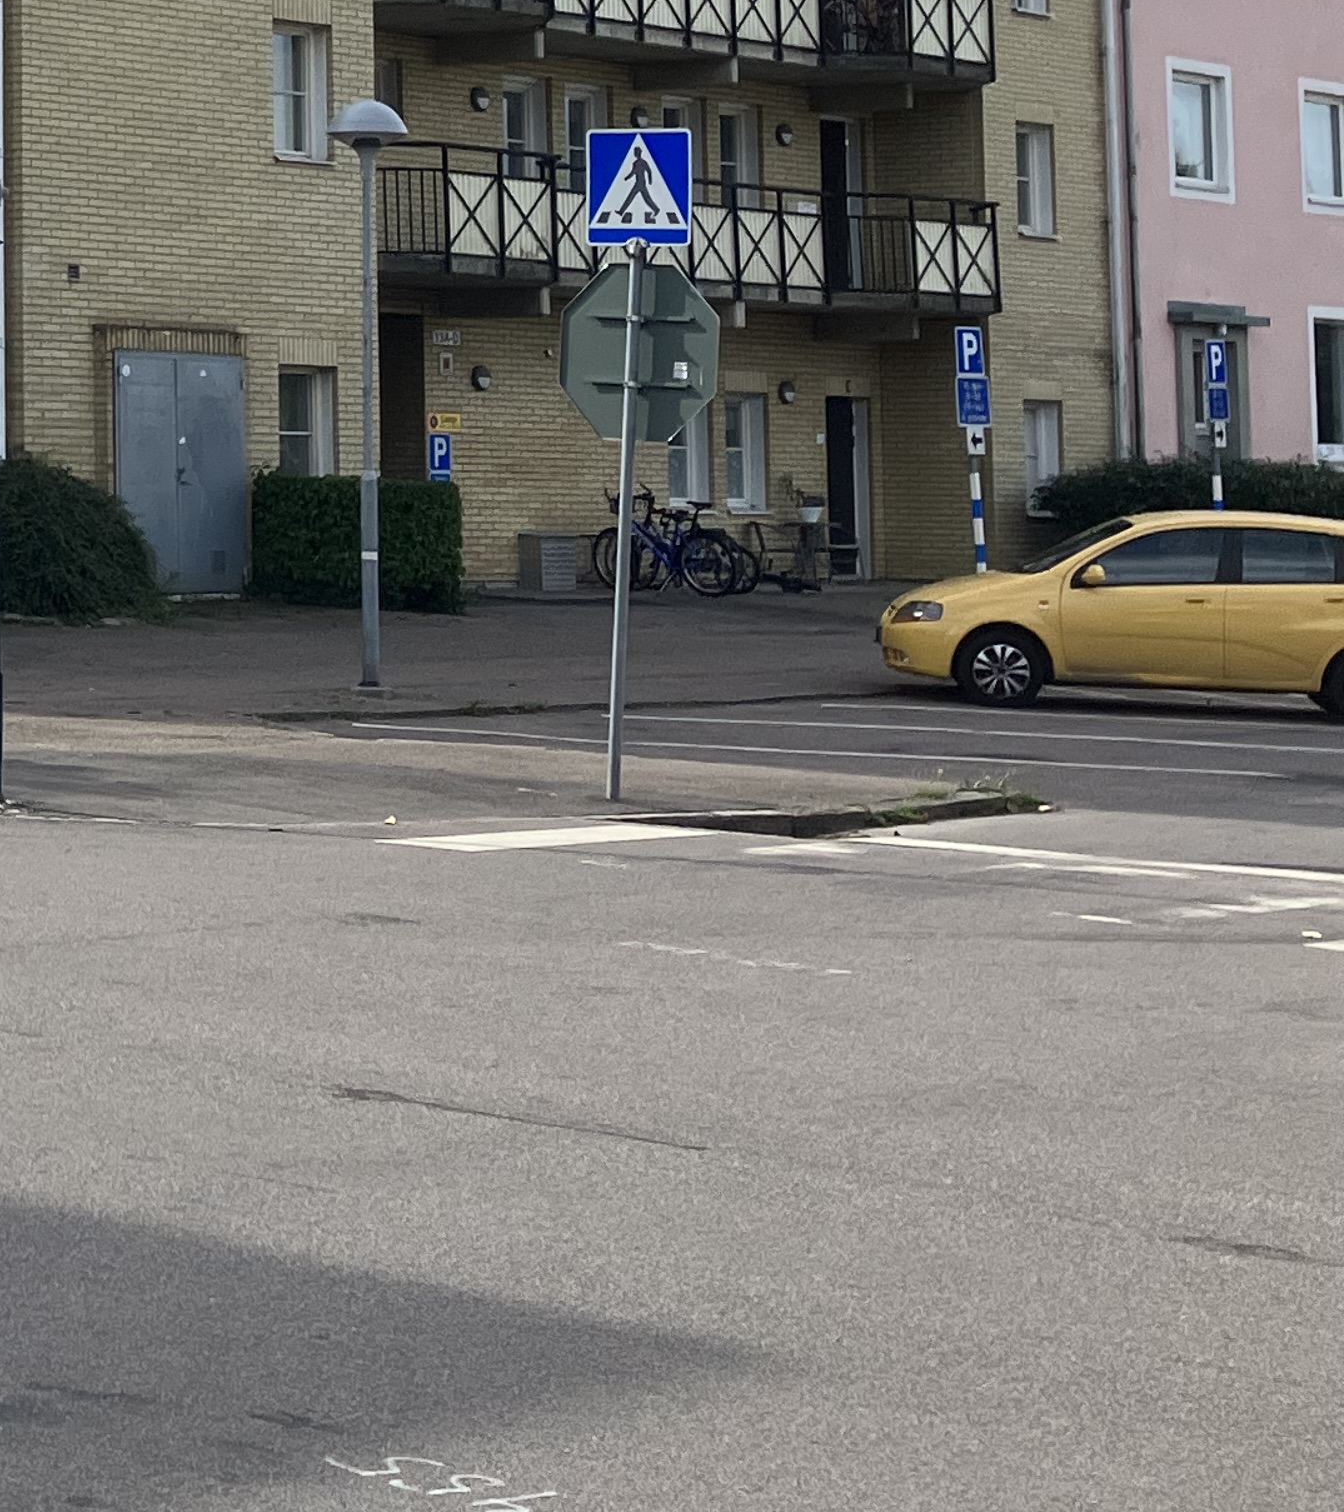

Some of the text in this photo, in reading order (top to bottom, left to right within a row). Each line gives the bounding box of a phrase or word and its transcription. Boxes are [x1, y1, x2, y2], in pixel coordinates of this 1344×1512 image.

[962, 332, 978, 371] P
[1210, 344, 1222, 381] P
[434, 437, 447, 469] P
